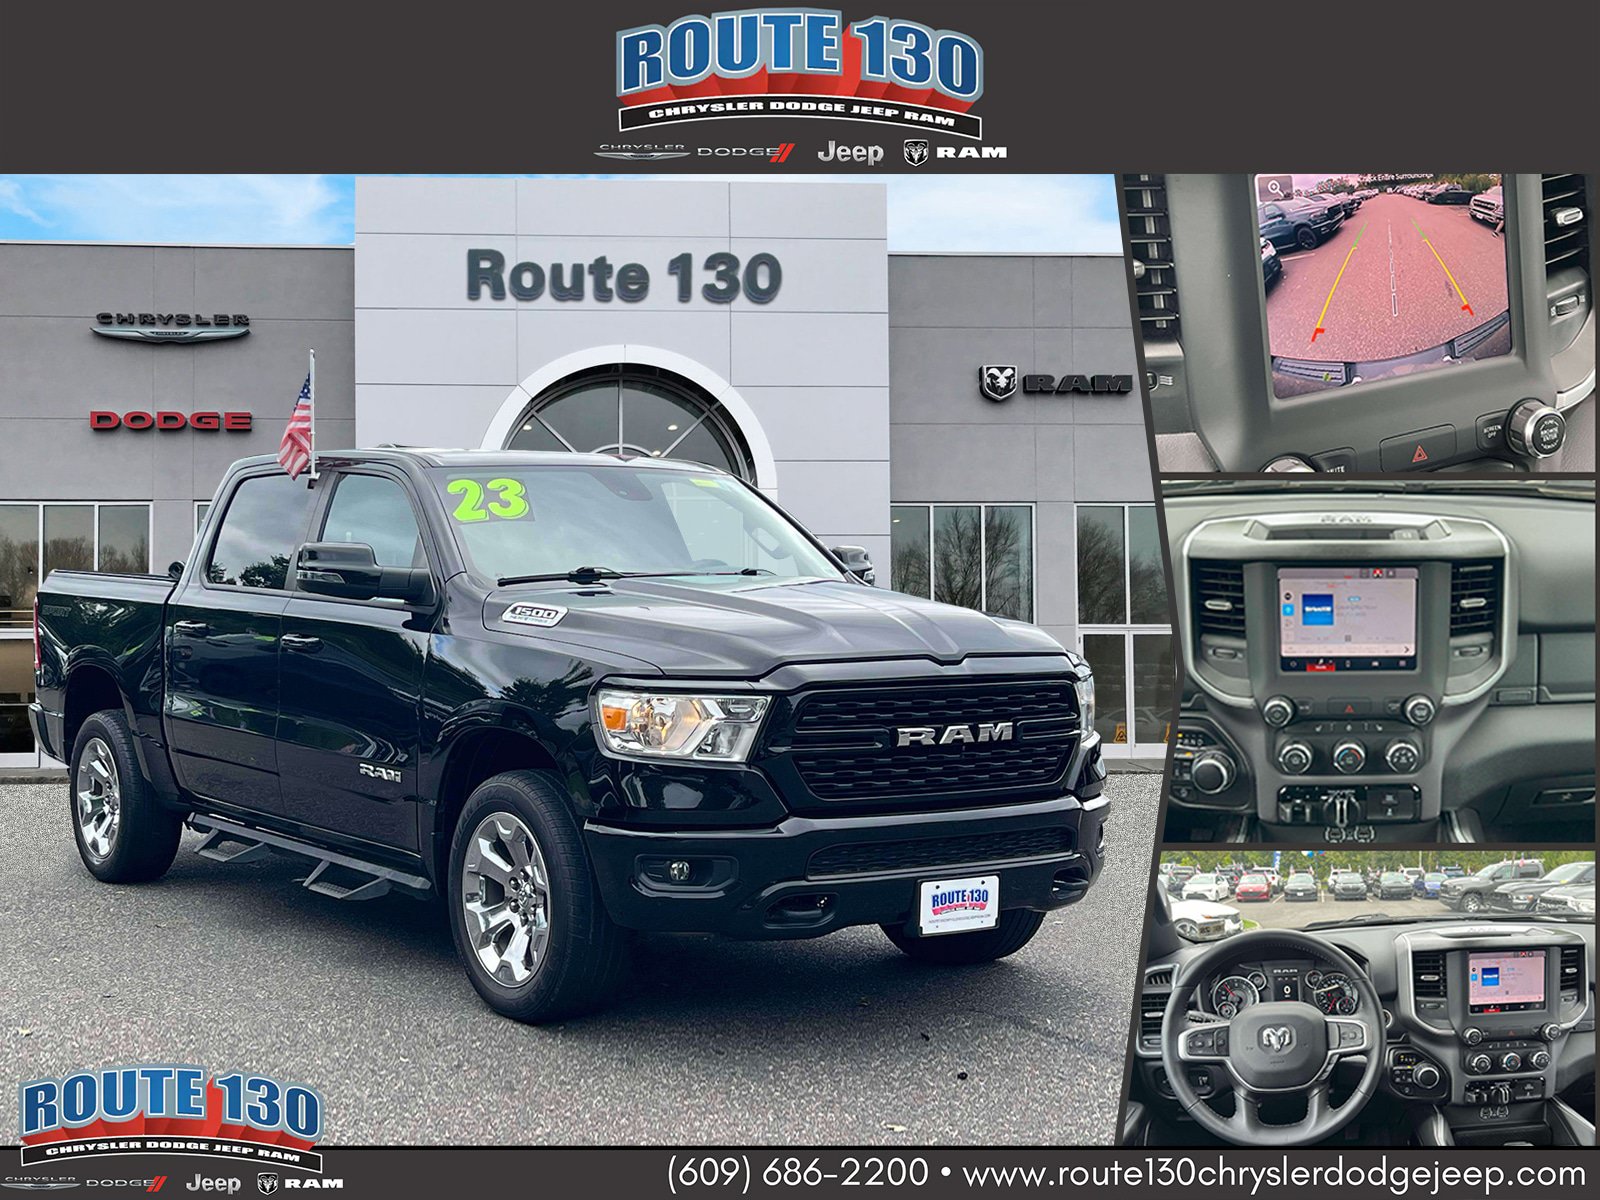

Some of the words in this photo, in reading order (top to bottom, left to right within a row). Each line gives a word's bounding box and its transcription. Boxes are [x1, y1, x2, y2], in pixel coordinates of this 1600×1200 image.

[467, 248, 650, 301] Route
[668, 252, 783, 305] 130
[96, 312, 250, 326] CHRYSLER
[1022, 374, 1134, 395] RAM
[90, 410, 252, 432] DODGE
[447, 478, 530, 522] 23
[515, 606, 558, 619] 1500
[897, 722, 1013, 747] RAM
[359, 763, 402, 783] RAM
[931, 889, 967, 908] ROUTE
[969, 888, 989, 903] 130
[1283, 985, 1291, 994] 0
